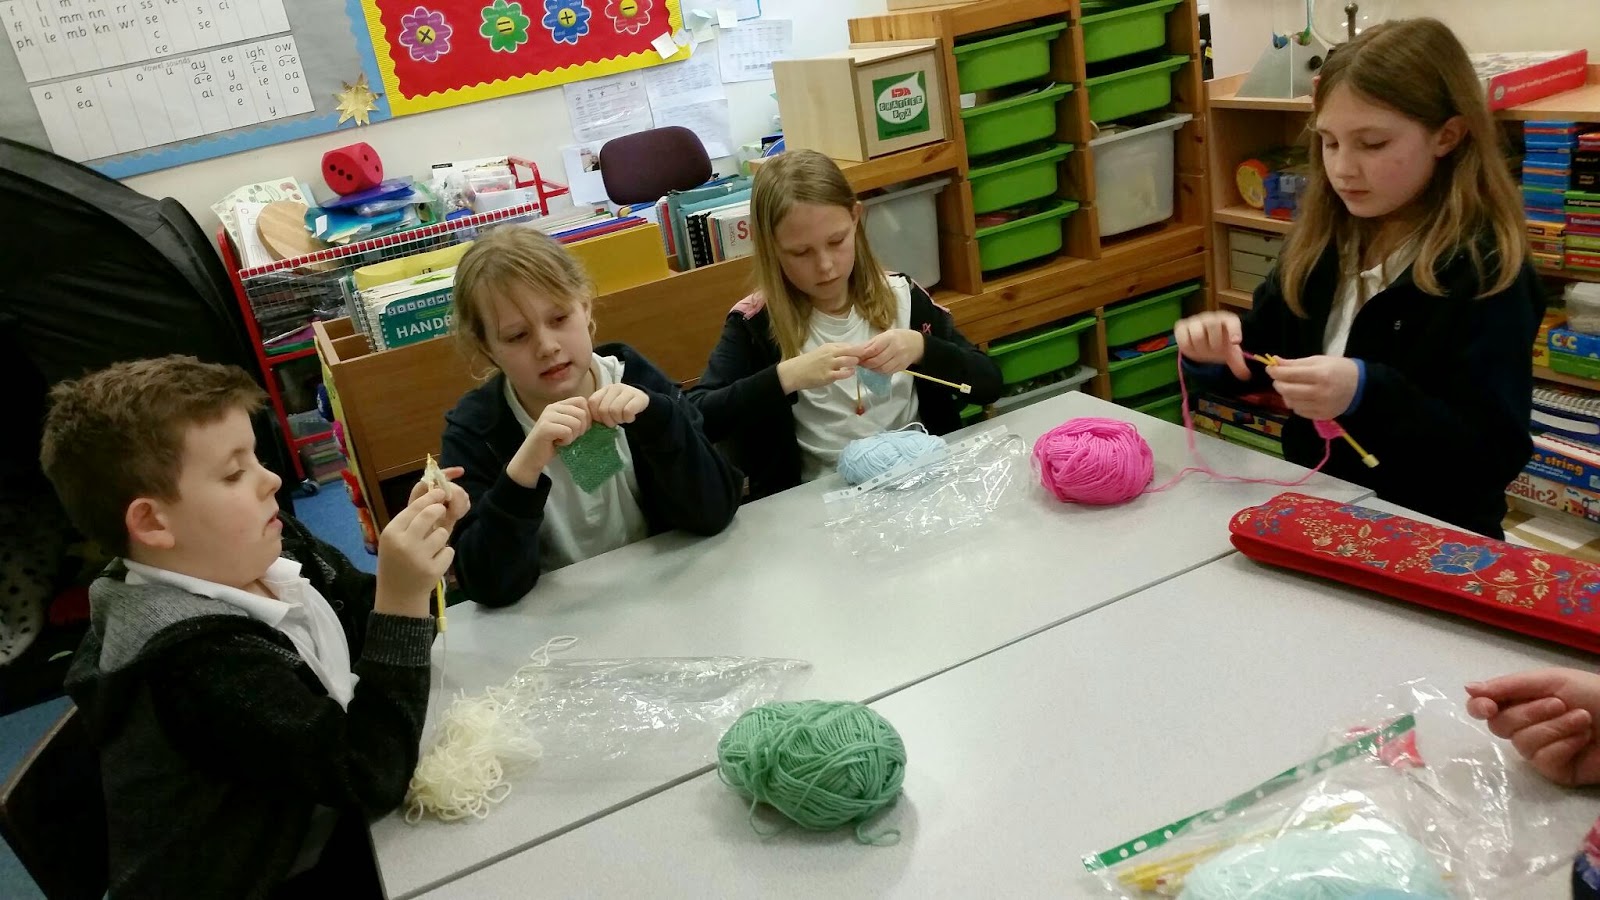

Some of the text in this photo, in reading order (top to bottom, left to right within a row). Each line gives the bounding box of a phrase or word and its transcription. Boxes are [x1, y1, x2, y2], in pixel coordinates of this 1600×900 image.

[14, 21, 23, 32] ff
[60, 13, 84, 25] mm
[88, 9, 106, 19] nn
[116, 4, 128, 14] rr
[199, 20, 211, 30] se
[16, 36, 35, 52] ph
[44, 32, 57, 44] le
[66, 27, 87, 40] mb
[93, 24, 111, 35] kn
[119, 19, 135, 30] wr
[145, 15, 159, 25] se
[155, 44, 169, 54] ce
[190, 60, 207, 72] ay
[220, 54, 234, 64] ee
[245, 46, 266, 61] igh
[274, 42, 292, 53] ow
[229, 83, 244, 93] ea
[258, 76, 270, 87] ie
[284, 71, 300, 81] oa
[77, 99, 93, 109] ea
[1551, 333, 1578, 350] CVC
[1545, 456, 1584, 477] string
